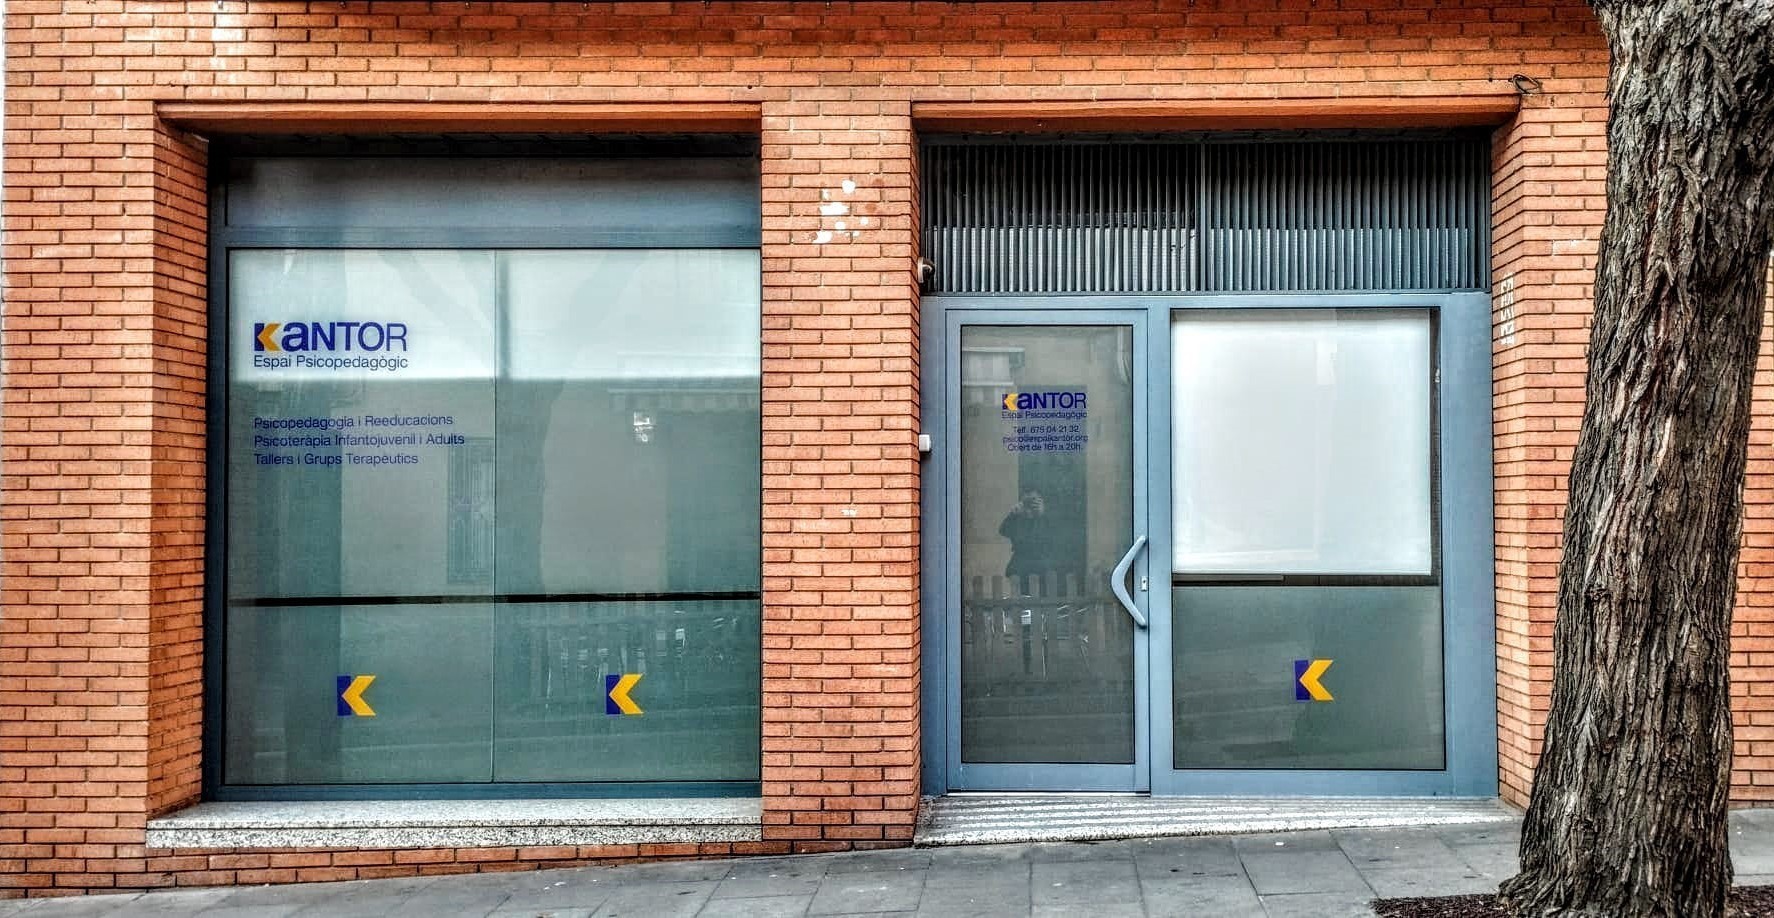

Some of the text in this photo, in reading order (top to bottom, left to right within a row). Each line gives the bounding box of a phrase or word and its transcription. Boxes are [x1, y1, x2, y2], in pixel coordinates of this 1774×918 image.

[254, 355, 408, 371] Espai Psicopedagògic
[254, 417, 354, 431] Psicopedagogia
[365, 414, 454, 427] Reeducacions
[254, 434, 331, 448] Psicoteràpia
[335, 433, 416, 448] Infantojuvenil
[426, 432, 465, 445] Adults
[254, 453, 294, 465] Tallers
[304, 453, 342, 467] Grups
